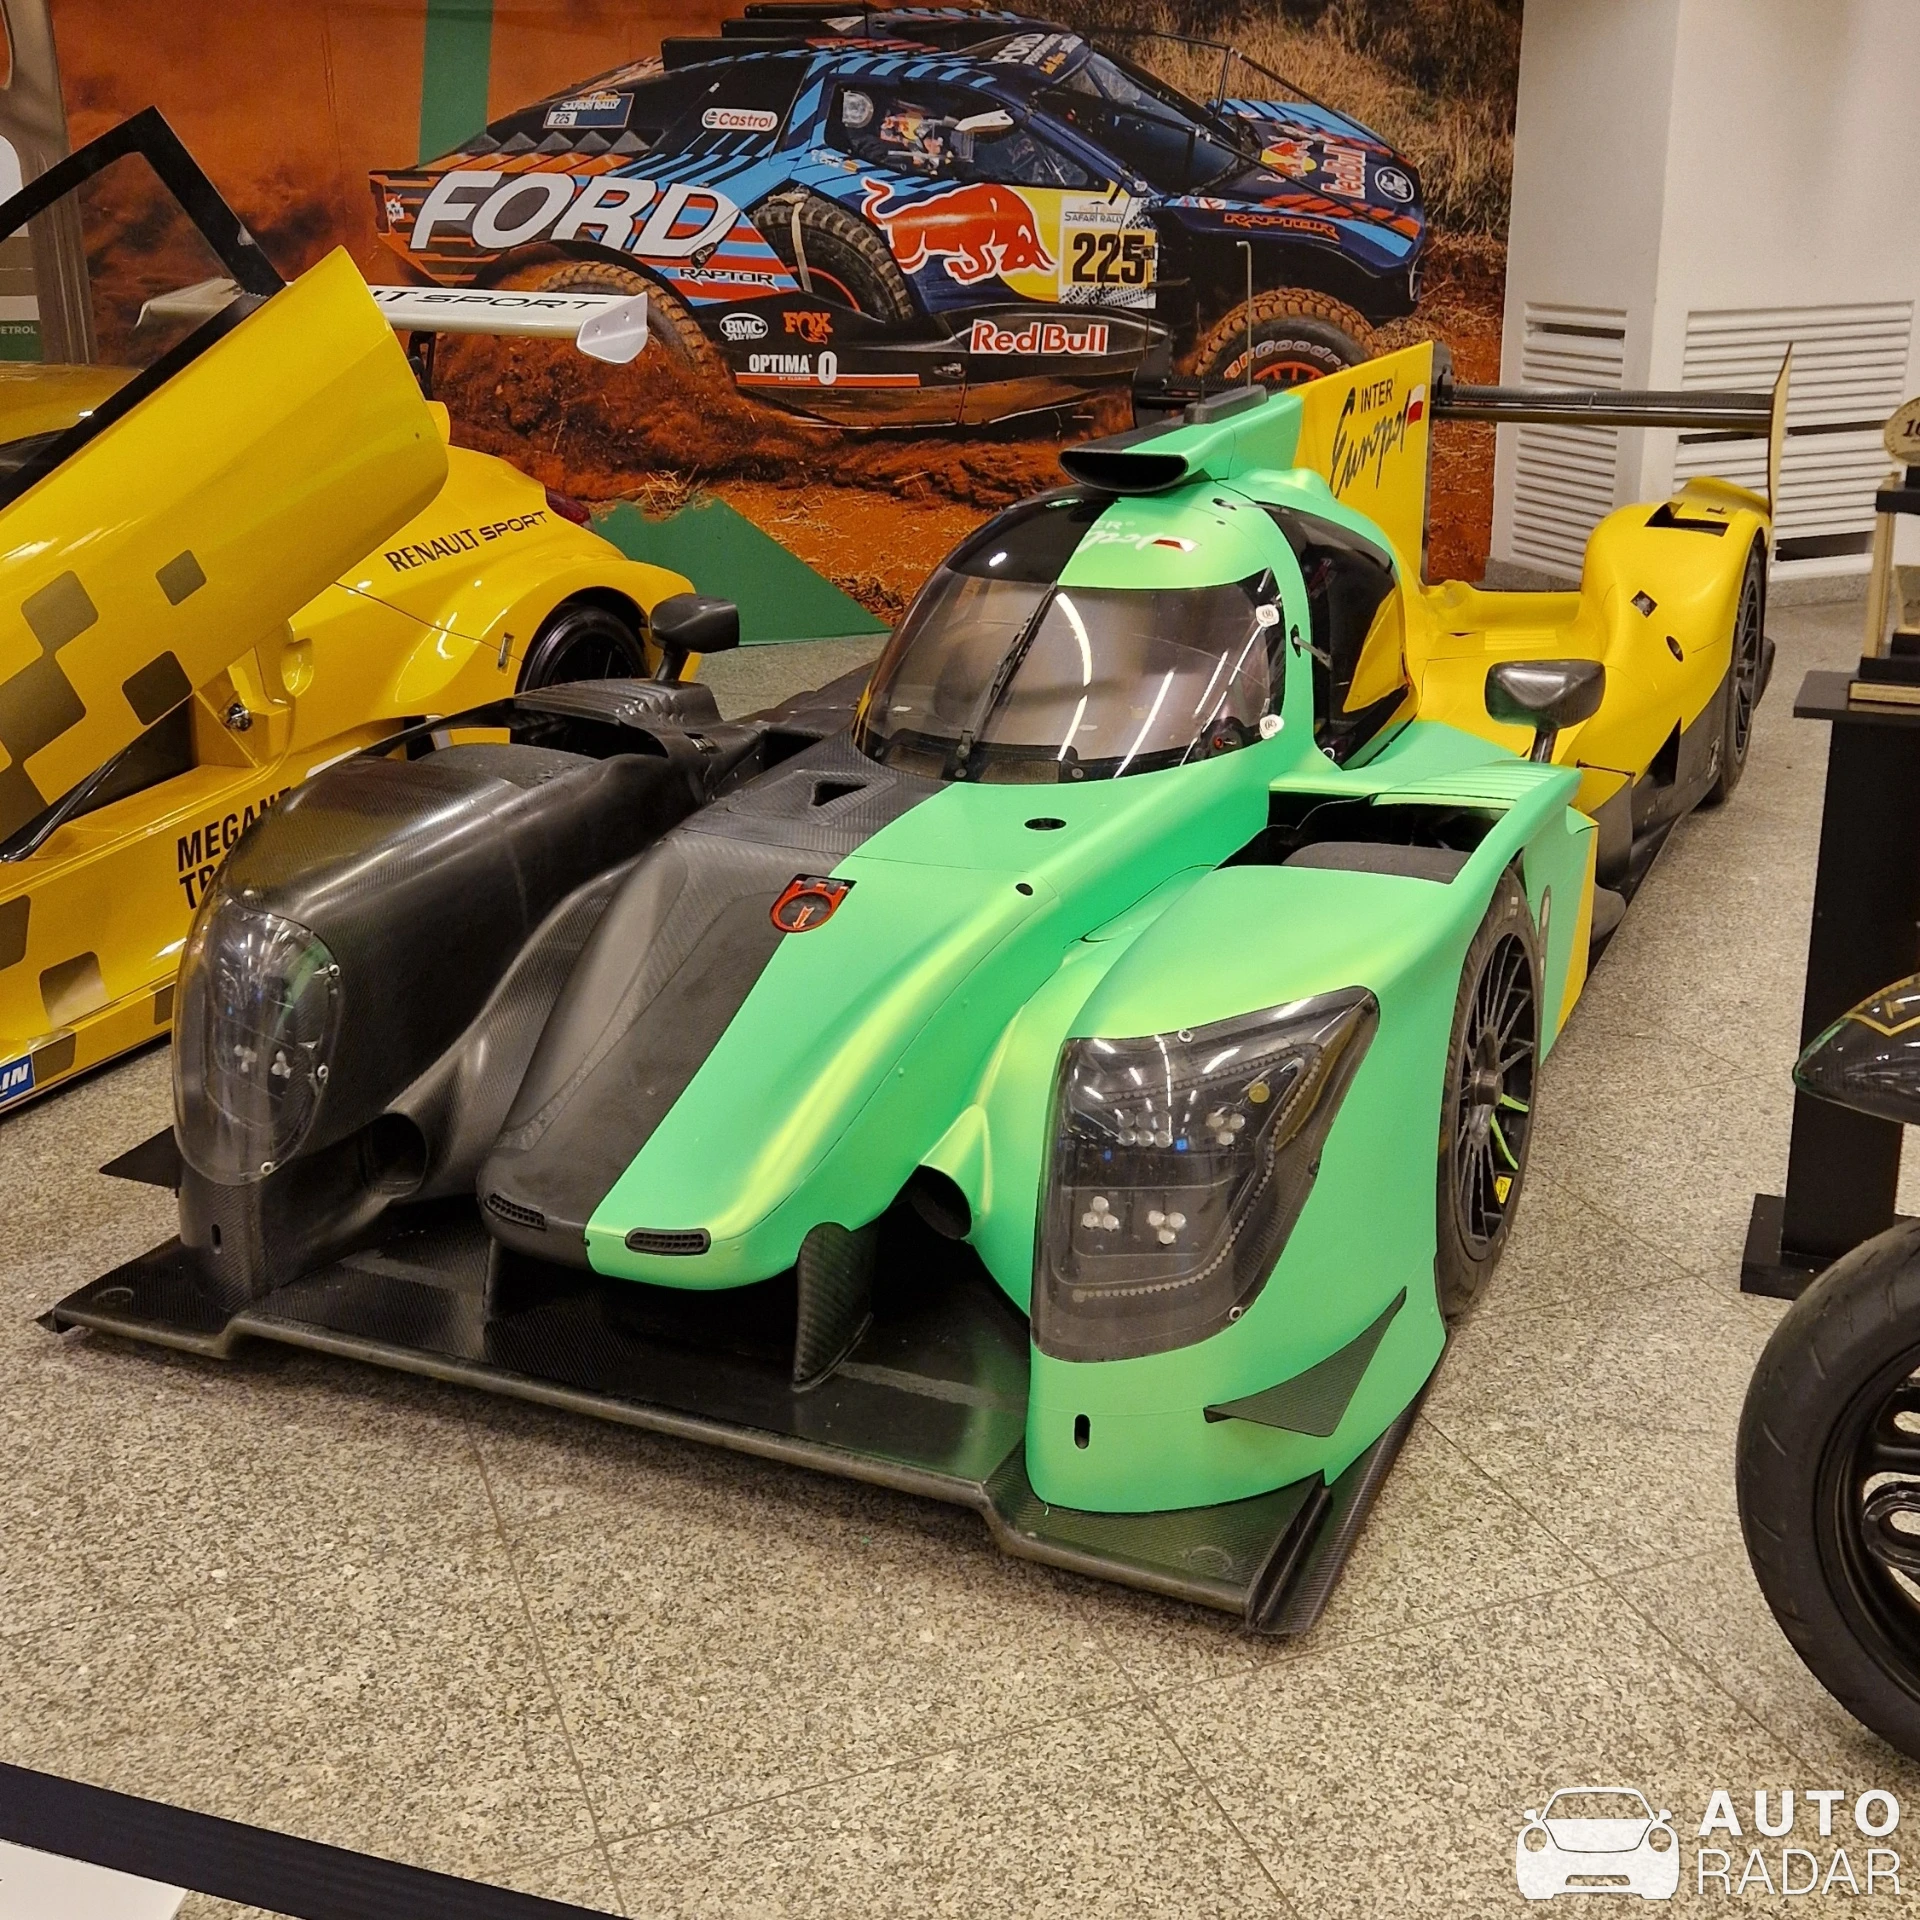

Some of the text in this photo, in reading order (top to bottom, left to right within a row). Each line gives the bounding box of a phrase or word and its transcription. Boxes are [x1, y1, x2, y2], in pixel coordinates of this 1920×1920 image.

[553, 113, 571, 124] 225
[718, 112, 774, 128] Castrol
[410, 170, 740, 257] FORD
[1072, 232, 1146, 284] 225
[679, 266, 780, 292] RAPTOR
[415, 294, 608, 310] SPORT
[0, 325, 37, 335] ETROL
[724, 320, 764, 334] BMC
[783, 311, 833, 345] FOX
[970, 319, 1109, 355] Red Bull
[748, 354, 811, 374] OPTIMA
[1360, 378, 1394, 414] INTER
[383, 510, 548, 573] RENAULT SPORT
